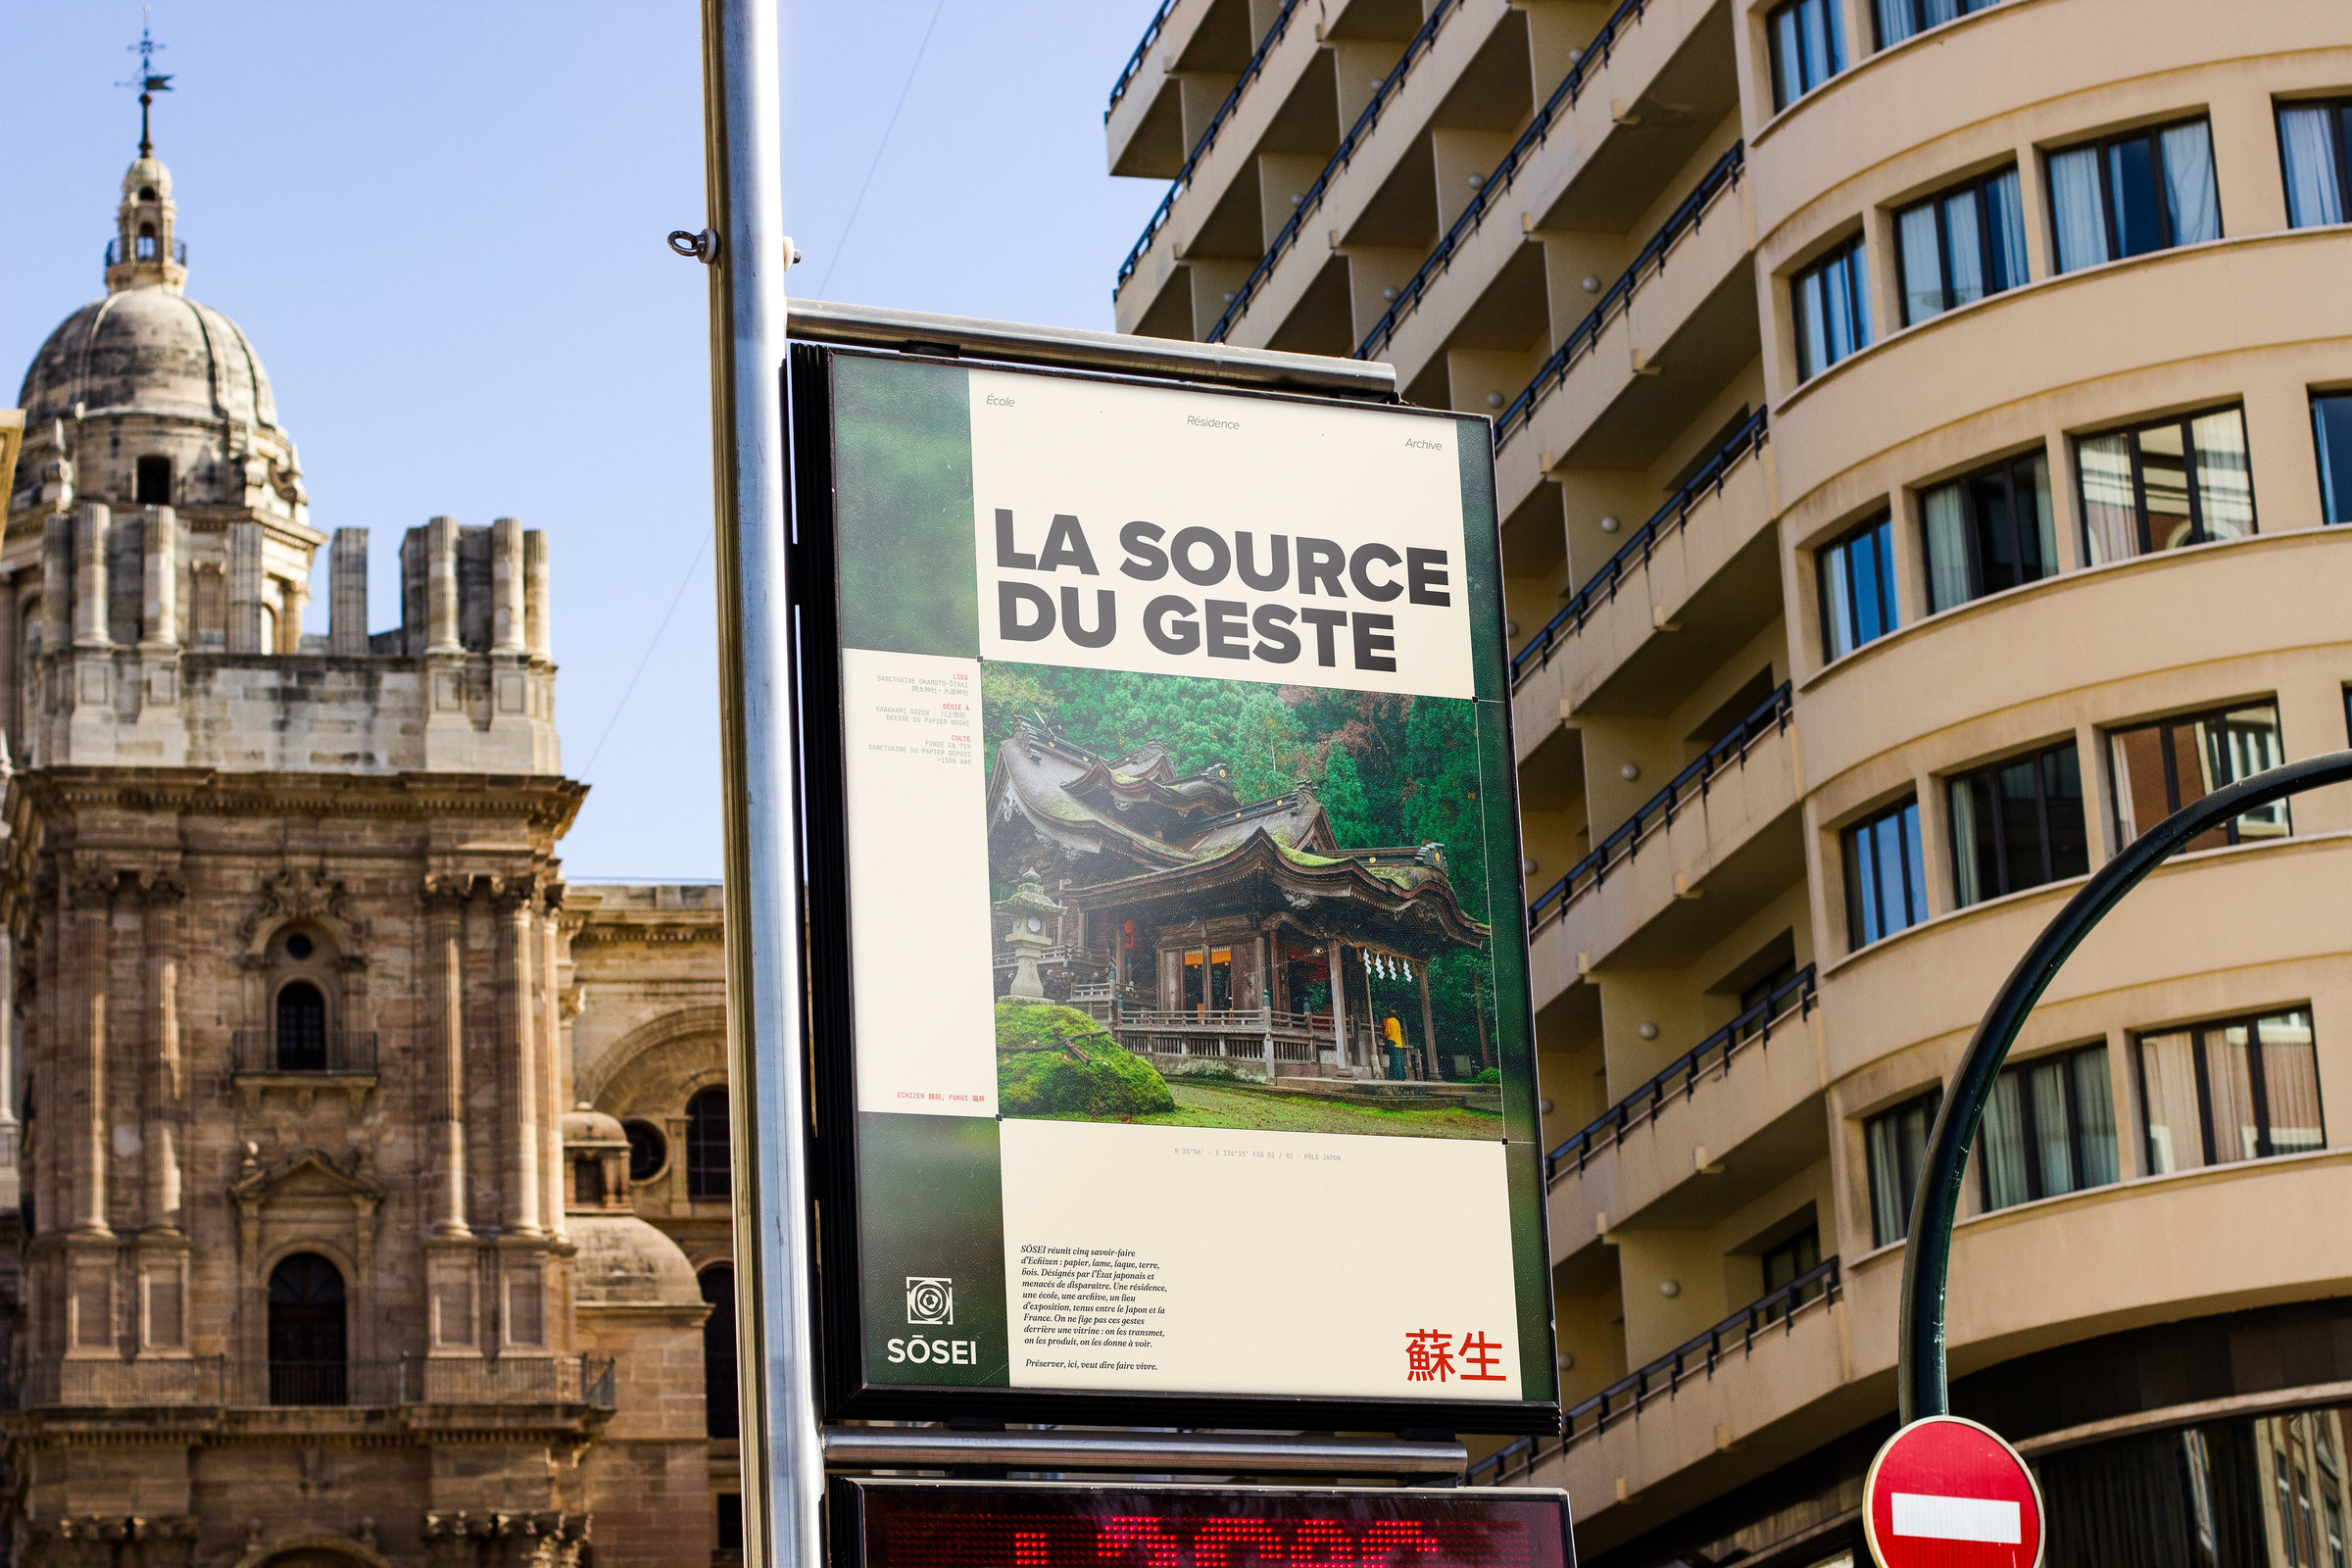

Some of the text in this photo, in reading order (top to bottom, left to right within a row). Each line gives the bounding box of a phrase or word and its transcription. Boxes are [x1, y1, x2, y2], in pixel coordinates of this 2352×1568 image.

[986, 394, 1015, 408] École
[1187, 415, 1240, 430] Résidence
[1405, 438, 1443, 451] Archive
[995, 508, 1451, 608] LA SOURCE
[998, 580, 1396, 672] DU GESTE
[877, 675, 915, 684] SANCTUAIRE
[875, 706, 906, 714] KAWAKAMI
[910, 708, 930, 716] GOZEN
[886, 713, 909, 722] DÉESSE
[868, 744, 906, 753] SANCTUAIRE
[897, 1091, 925, 1100] ECHIZEN
[1048, 1246, 1071, 1254] réunit
[1072, 1248, 1090, 1257] cinq
[1091, 1249, 1136, 1257] savoir-faire
[1063, 1258, 1091, 1268] papier,
[1092, 1258, 1113, 1268] lame,
[1114, 1259, 1137, 1270] laque,
[1021, 1267, 1039, 1276] bois.
[1041, 1268, 1075, 1279] Désignés
[1076, 1271, 1091, 1280] par
[1112, 1271, 1146, 1281] japonais
[1113, 1282, 1128, 1291] Une
[1129, 1284, 1167, 1293] résidence,
[1039, 1291, 1060, 1300] école,
[1077, 1293, 1108, 1302] archive,
[1121, 1294, 1136, 1302] lieu
[1117, 1304, 1124, 1313] le
[1125, 1305, 1148, 1315] Japon
[1023, 1313, 1053, 1322] France.
[1054, 1313, 1066, 1322] On
[1078, 1314, 1093, 1325] fige
[1094, 1316, 1107, 1325] pas
[1023, 1324, 1056, 1333] derrière
[1073, 1326, 1100, 1335] vitrine
[1116, 1327, 1127, 1336] les
[1128, 1329, 1165, 1338] transmet,
[1036, 1336, 1047, 1345] les
[1048, 1337, 1078, 1347] produit,
[1103, 1339, 1127, 1348] donne
[1128, 1339, 1133, 1348] à
[887, 1335, 977, 1365] SŌSEI
[1405, 1328, 1506, 1383] 蘇生
[1025, 1358, 1066, 1369] Préserver,
[1067, 1360, 1079, 1369] ici,
[1116, 1361, 1135, 1371] faire
